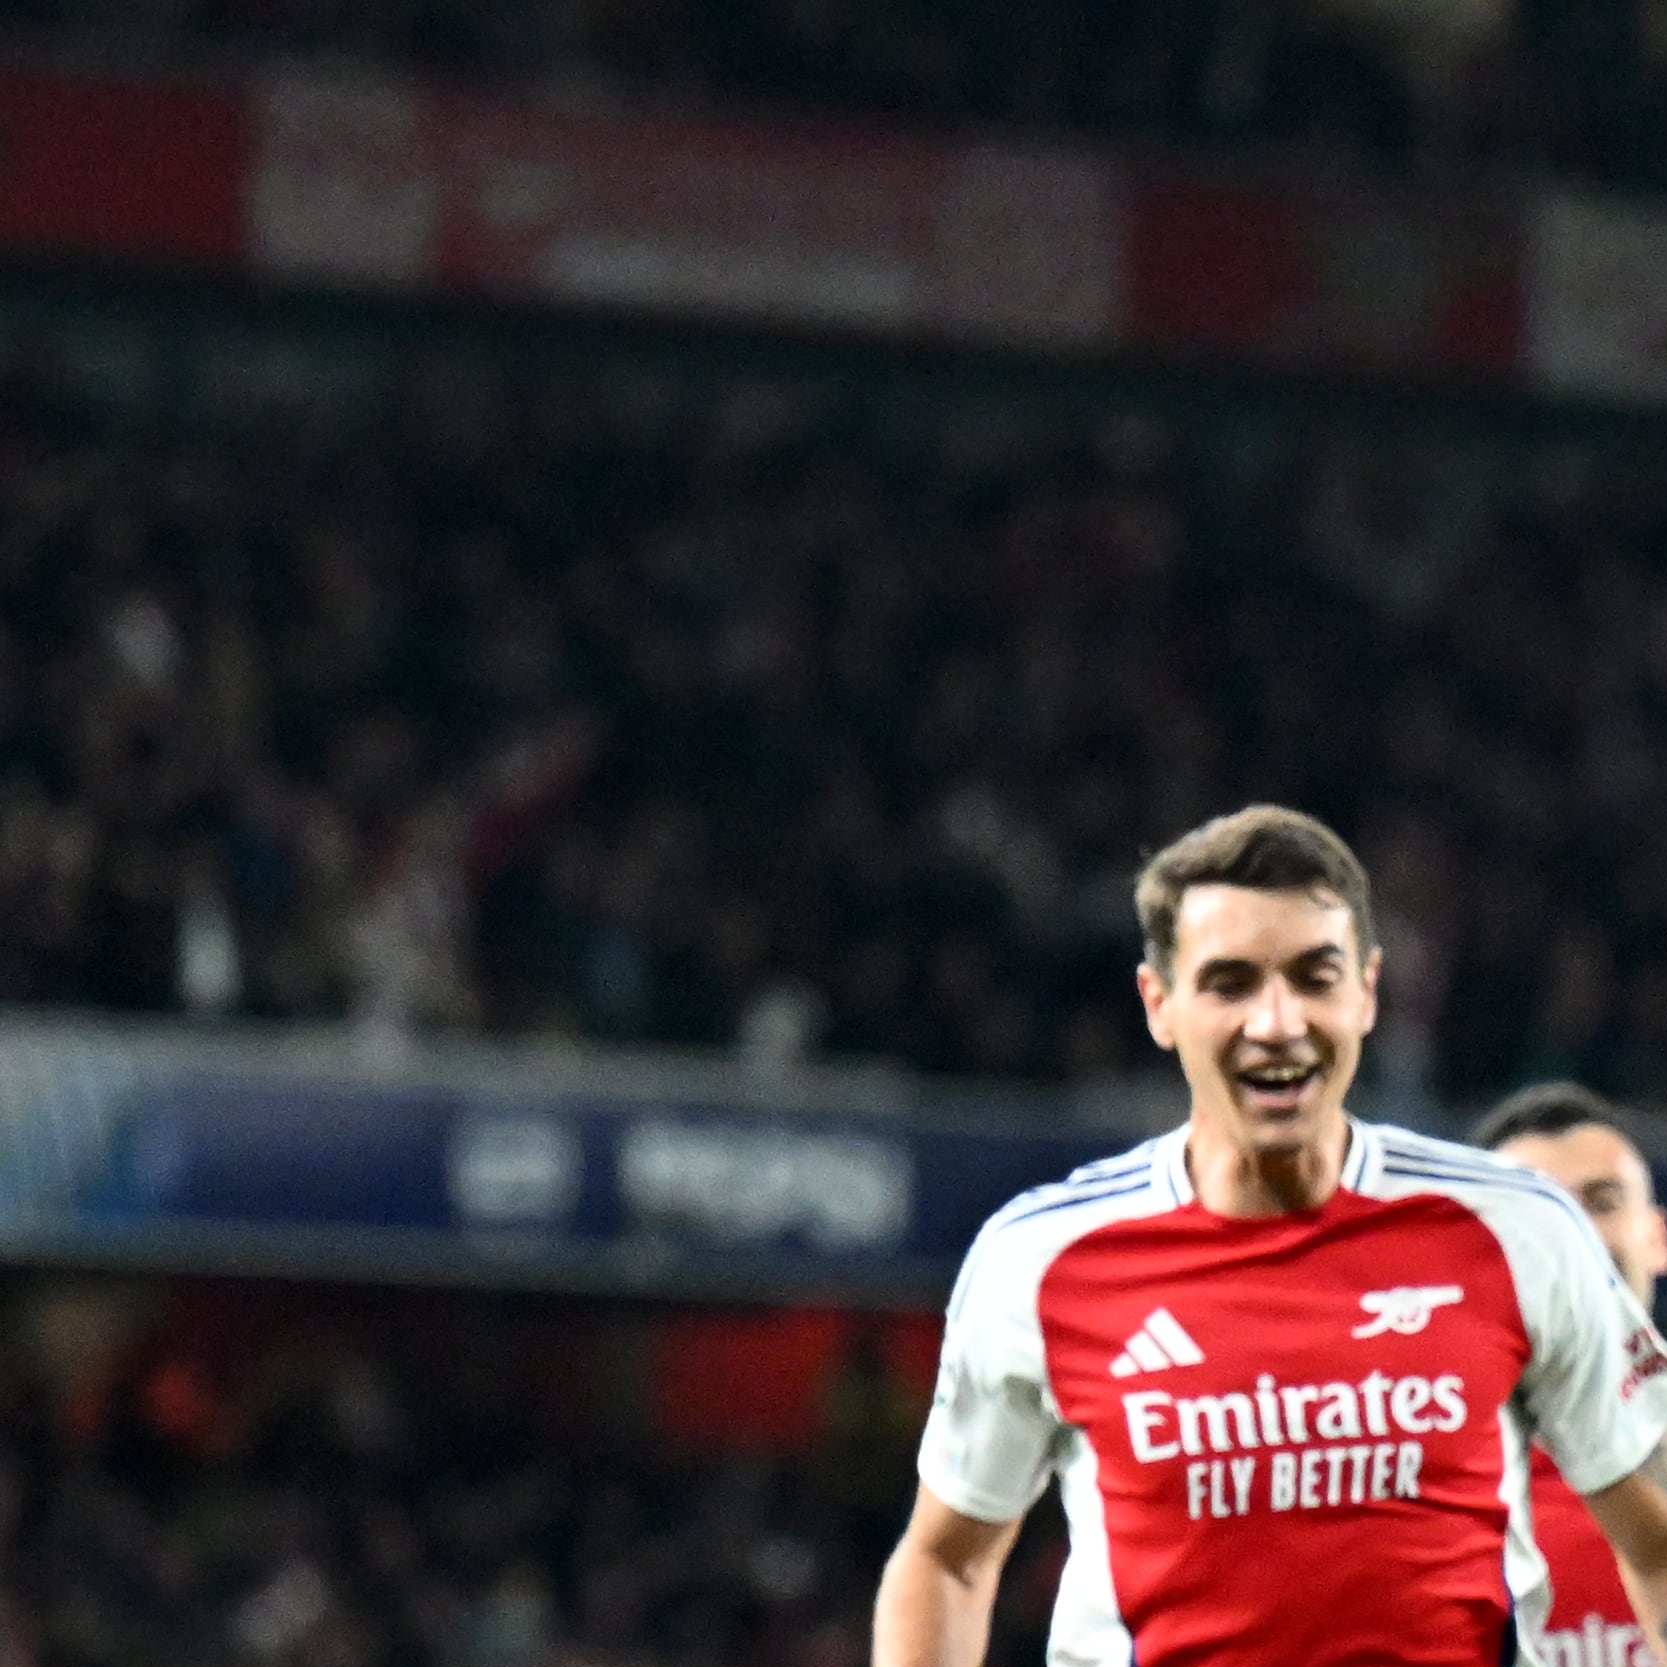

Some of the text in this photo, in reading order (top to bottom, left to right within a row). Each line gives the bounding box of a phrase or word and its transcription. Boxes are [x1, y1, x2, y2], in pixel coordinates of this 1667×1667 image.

[1121, 1369, 1468, 1465] Emirates
[1185, 1440, 1424, 1521] FLY BETTER
